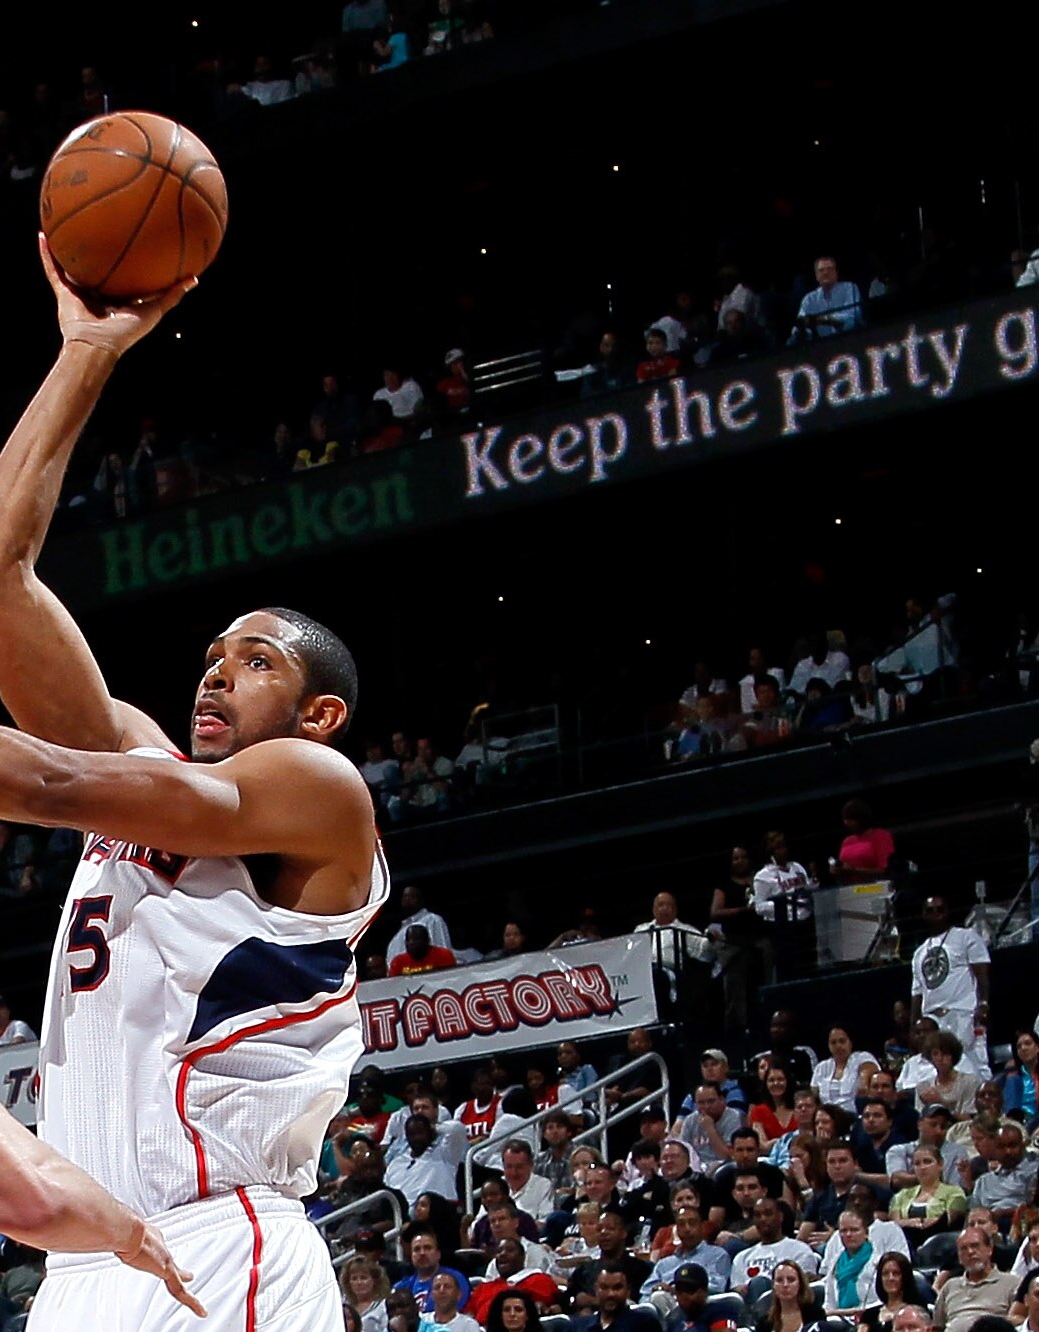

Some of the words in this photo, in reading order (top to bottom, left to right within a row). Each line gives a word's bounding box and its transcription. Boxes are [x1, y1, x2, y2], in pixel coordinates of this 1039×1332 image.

[463, 412, 629, 498] Keep
[645, 374, 760, 450] the
[777, 323, 971, 437] party
[99, 473, 416, 597] Heineken
[402, 963, 616, 1048] FACTORY
